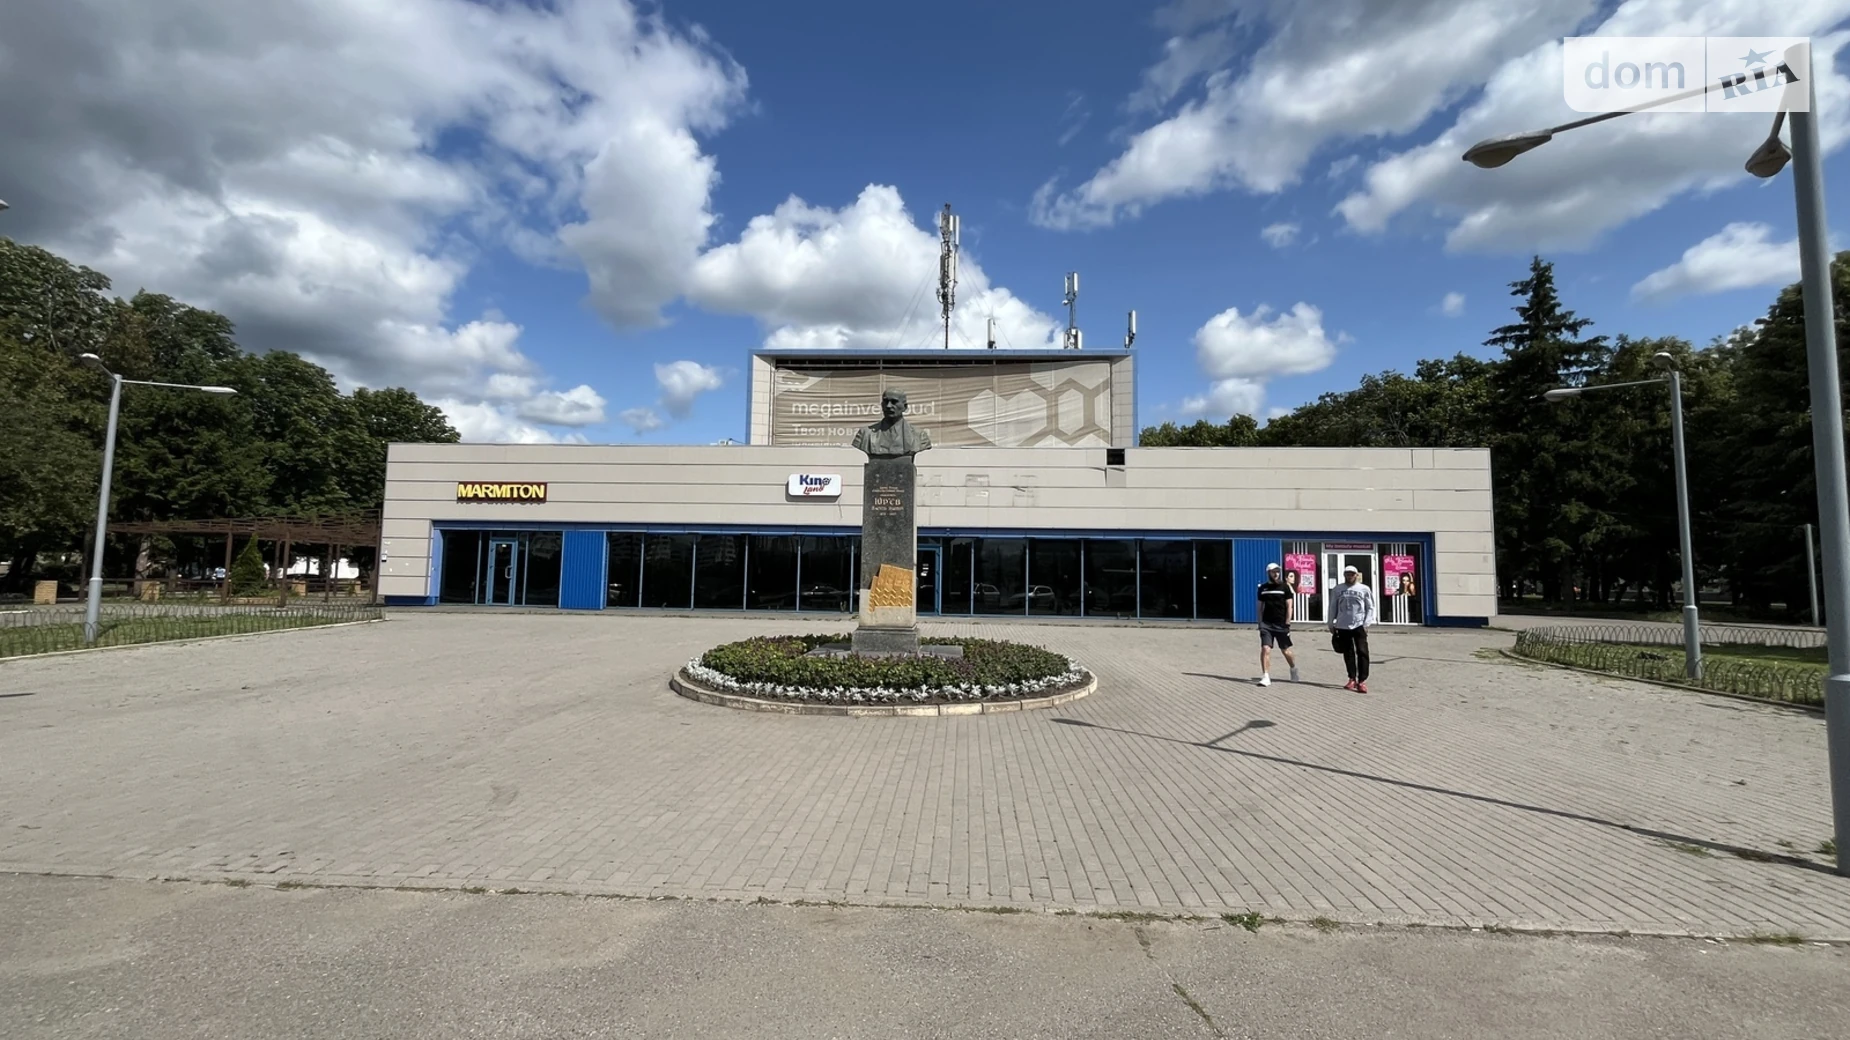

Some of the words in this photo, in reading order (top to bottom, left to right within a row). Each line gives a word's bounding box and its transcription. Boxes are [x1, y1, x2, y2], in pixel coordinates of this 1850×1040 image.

[792, 401, 935, 419] megainveud
[792, 424, 825, 436] Твоя
[799, 474, 832, 486] Kino
[458, 484, 545, 498] MARMITON
